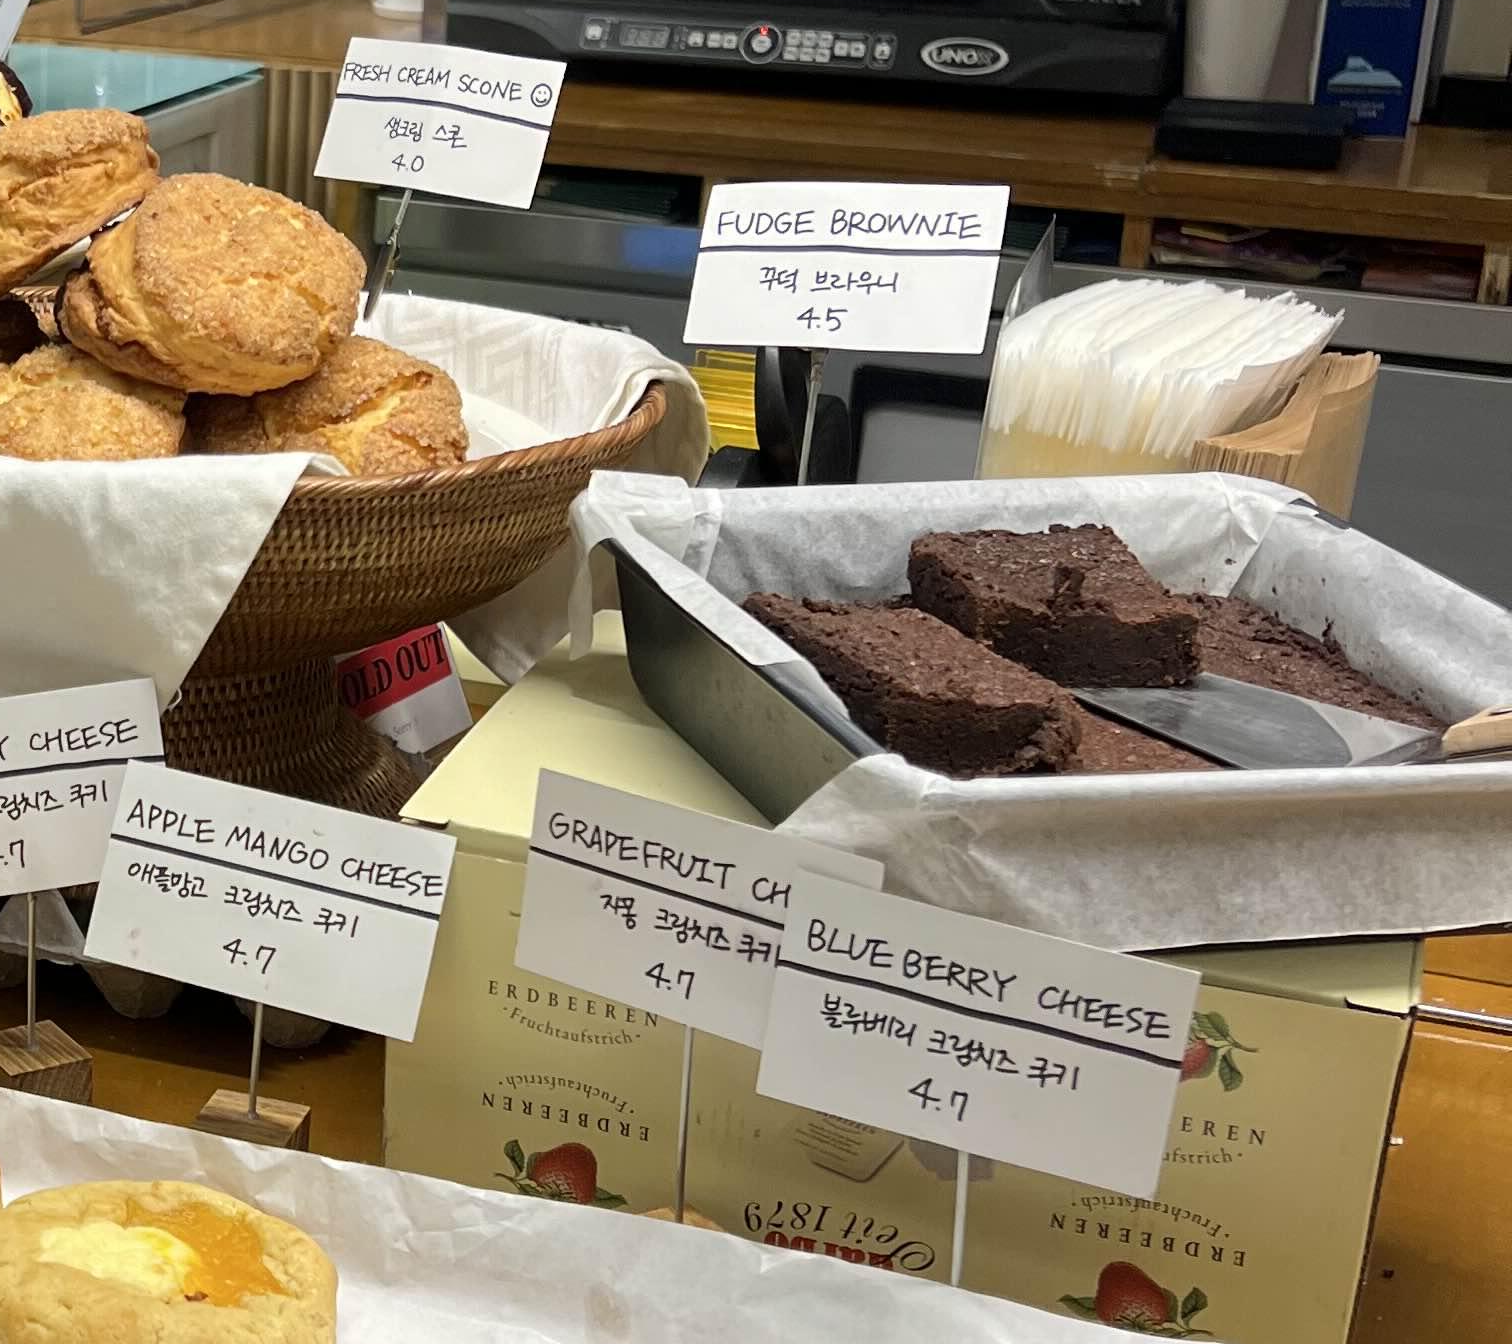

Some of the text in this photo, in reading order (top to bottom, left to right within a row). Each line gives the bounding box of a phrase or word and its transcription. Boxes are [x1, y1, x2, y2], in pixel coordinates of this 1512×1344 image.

[344, 63, 523, 101] FRESH CREAM SCONE
[432, 124, 467, 149] 스콘
[391, 154, 425, 173] 4.0
[717, 209, 982, 239] FUDGE BROWNIE
[759, 266, 899, 295] 꾸덕 브라우니
[796, 307, 849, 332] 4.5
[341, 629, 445, 706] OLD OUT
[29, 718, 138, 752] CHEESE
[69, 779, 108, 808] 쿠키
[126, 798, 444, 897] APPLE MANGO CHEESE
[548, 812, 737, 890] GRAPEFRUIT
[127, 862, 208, 899] 애플망고
[313, 907, 360, 938] 쿠키
[599, 894, 637, 930] 자몽
[736, 934, 782, 968] 쿠키
[222, 938, 277, 975] 4.7
[644, 962, 696, 1000] 4.7
[488, 979, 660, 1028] ERDBEEREN
[1038, 985, 1171, 1039] CHEESE
[820, 993, 918, 1047] 블루베리
[1026, 1057, 1080, 1091] 쿠키
[482, 1092, 650, 1143] ERDBEEREN
[908, 1077, 969, 1122] 4.7
[743, 1201, 832, 1234] 1879
[1049, 1212, 1247, 1268] ERDBEEREN
